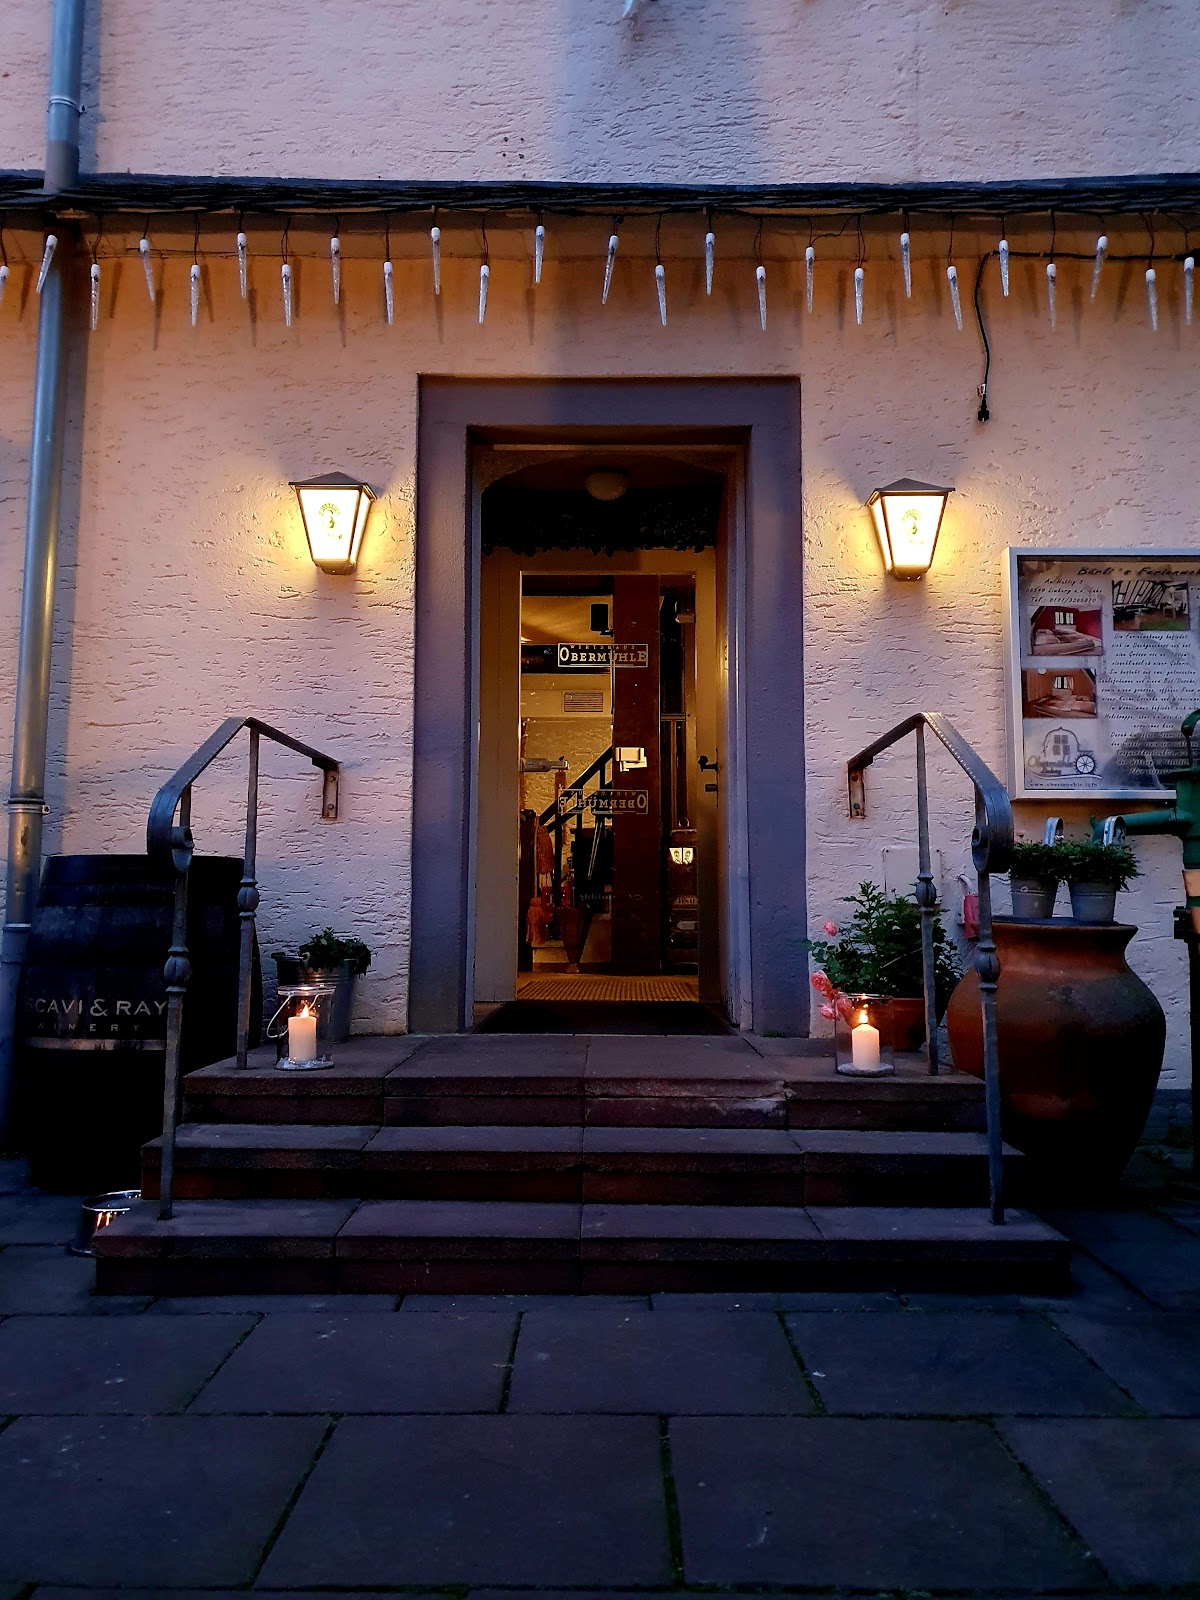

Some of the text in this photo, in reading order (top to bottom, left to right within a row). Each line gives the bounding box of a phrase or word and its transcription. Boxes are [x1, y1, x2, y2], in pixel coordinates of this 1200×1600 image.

[560, 646, 648, 662] OBERMÜHLE
[89, 998, 108, 1016] &
[116, 1000, 168, 1015] RAY
